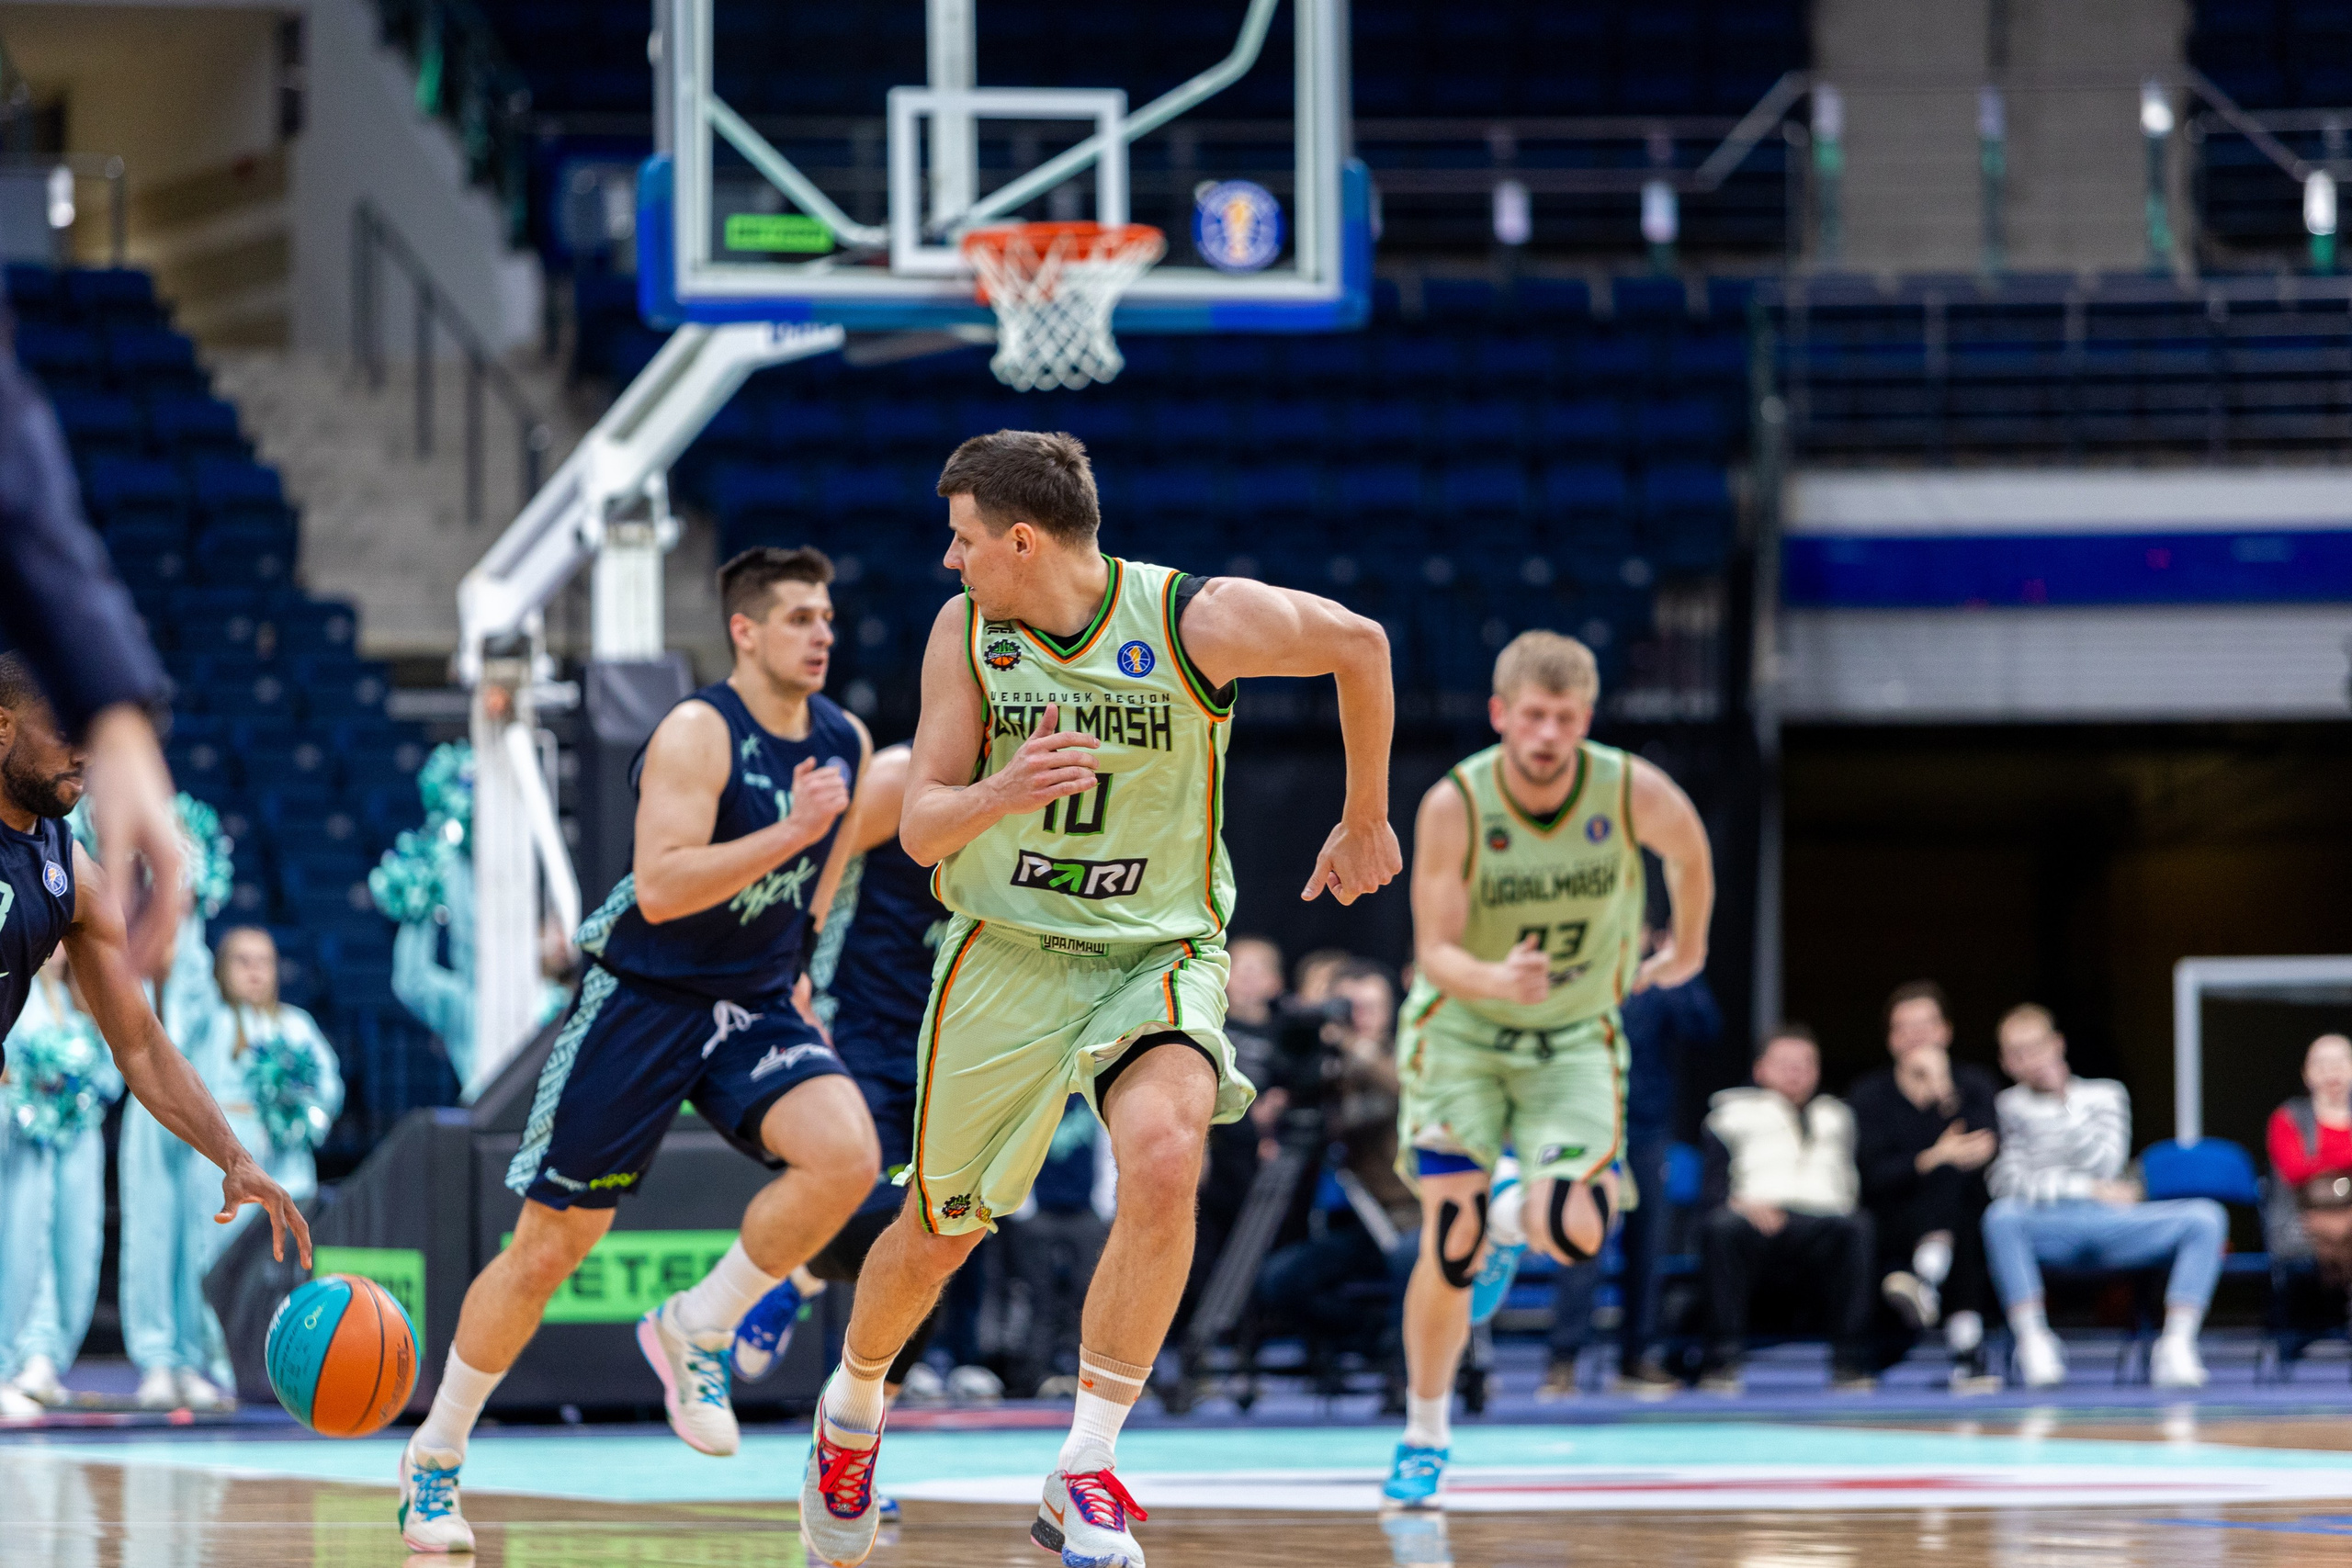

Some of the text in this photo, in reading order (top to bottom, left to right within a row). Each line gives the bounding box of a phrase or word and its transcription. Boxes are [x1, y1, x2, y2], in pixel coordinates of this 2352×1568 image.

[1104, 693, 1171, 705] REGION
[1016, 854, 1142, 895] PARI
[1043, 934, 1106, 954] УРАЛМАШ
